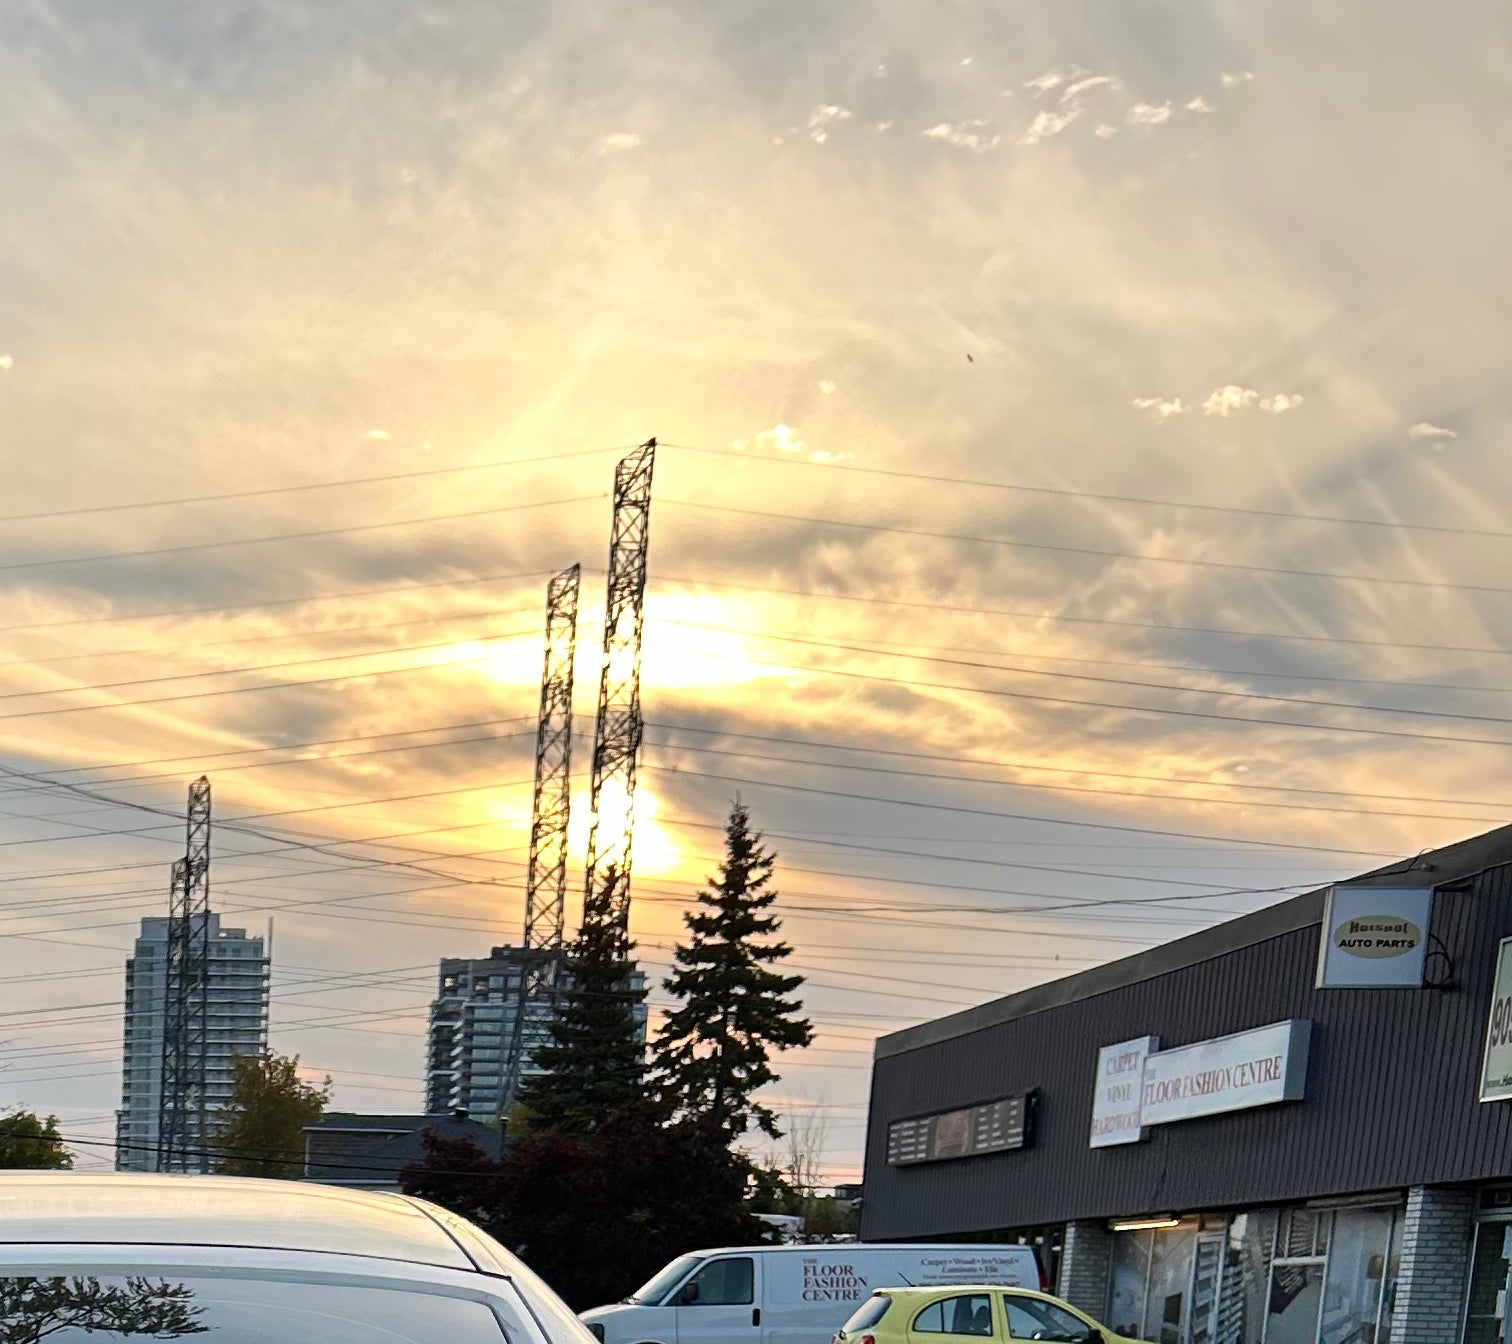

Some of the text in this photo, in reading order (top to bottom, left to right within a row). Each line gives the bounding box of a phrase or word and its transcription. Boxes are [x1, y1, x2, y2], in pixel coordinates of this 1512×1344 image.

[1338, 939, 1415, 948] AUTO PARTS
[1143, 1055, 1283, 1106] FLOOR FASHION CENTRE
[803, 1265, 853, 1276] FLOOR
[803, 1277, 868, 1288] FASHION
[802, 1289, 861, 1301] CENTRE
